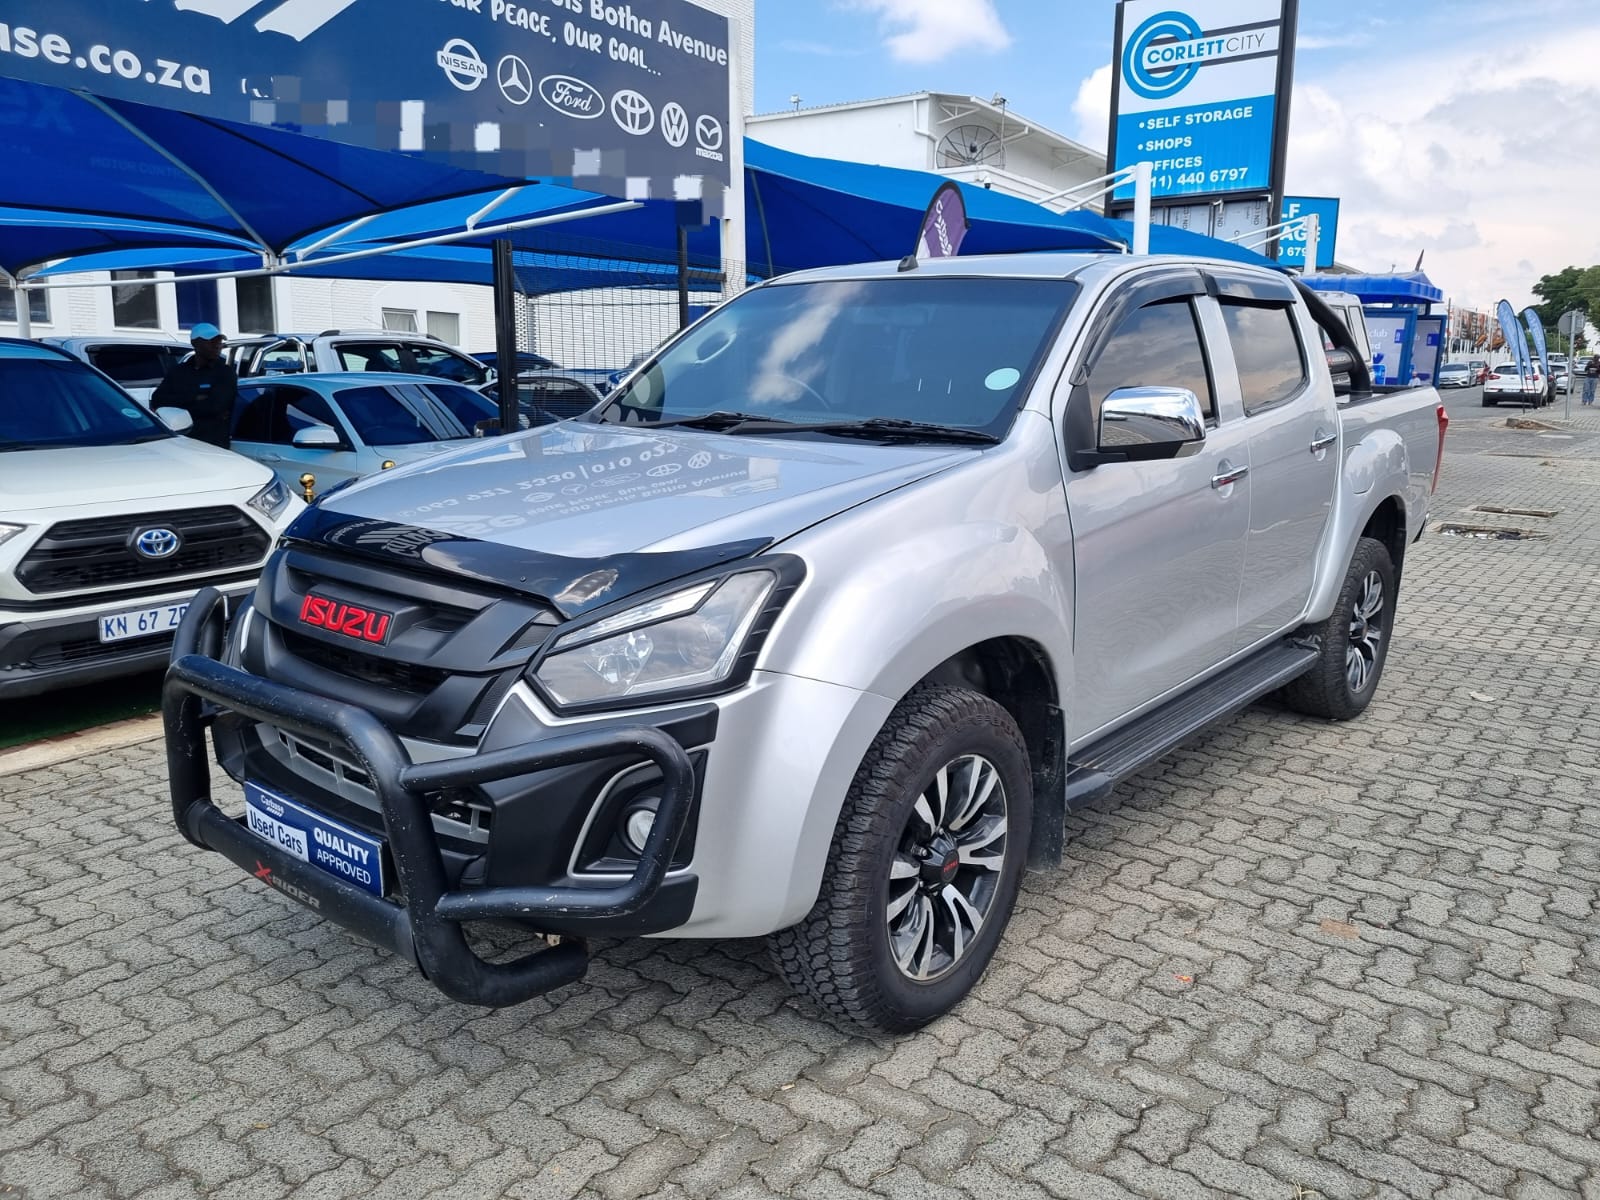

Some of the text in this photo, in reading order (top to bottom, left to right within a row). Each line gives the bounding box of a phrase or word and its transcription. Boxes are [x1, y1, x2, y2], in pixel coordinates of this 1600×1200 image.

[563, 22, 603, 54] OUR
[590, 0, 728, 66] Botha Avenue
[440, 55, 485, 75] NISSAN
[551, 80, 593, 112] Ford
[1146, 106, 1253, 130] SELF STORAGE
[1145, 136, 1192, 152] SHOPS
[1151, 156, 1203, 171] FFICES
[1176, 171, 1205, 185] 440
[1209, 167, 1248, 182] 6797
[104, 616, 128, 638] KN
[138, 611, 159, 631] 67
[299, 594, 390, 643] ISUZU
[249, 810, 303, 855] Used Cars
[313, 827, 370, 865] QUALITY
[316, 849, 371, 885] APPROVED
